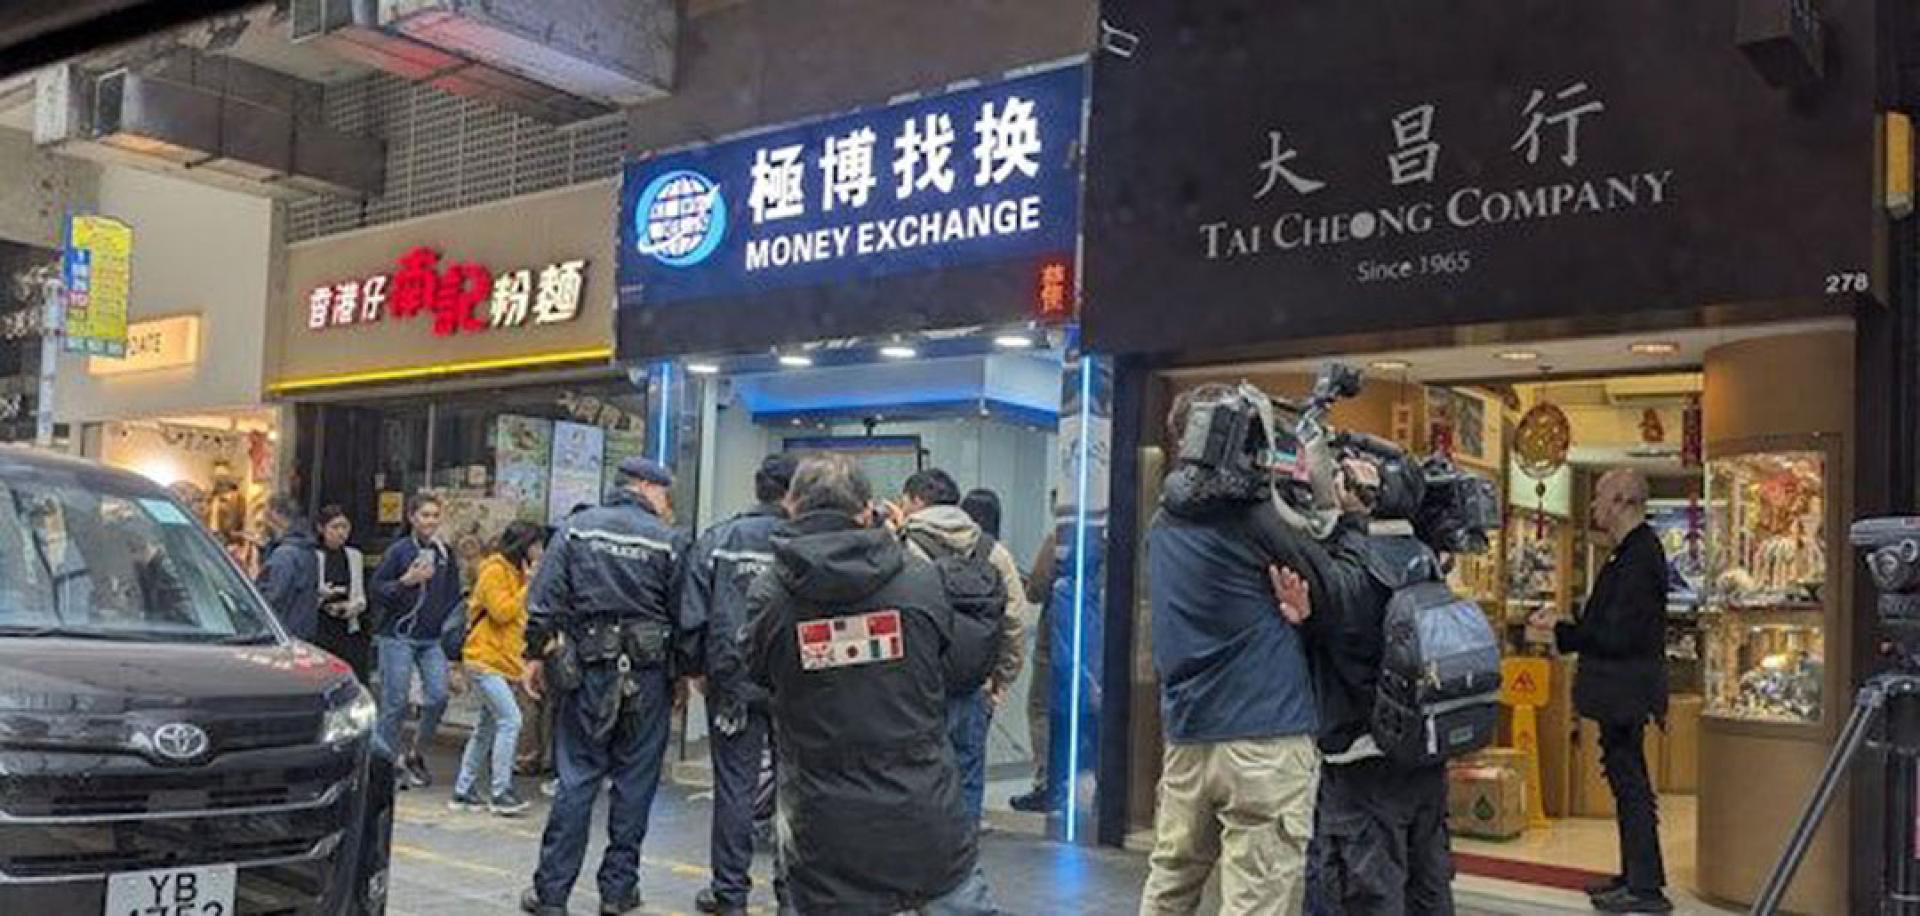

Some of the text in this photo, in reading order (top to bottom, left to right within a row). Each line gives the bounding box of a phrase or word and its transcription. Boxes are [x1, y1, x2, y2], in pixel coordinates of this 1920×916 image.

[1253, 83, 1605, 199] 大昌行
[745, 196, 1041, 271] MONEY EXCHANGE
[1200, 170, 1674, 258] TAI CHEONG COMPANY
[1357, 250, 1471, 282] Since 1965
[1825, 271, 1869, 293] 278
[149, 872, 198, 904] YB
